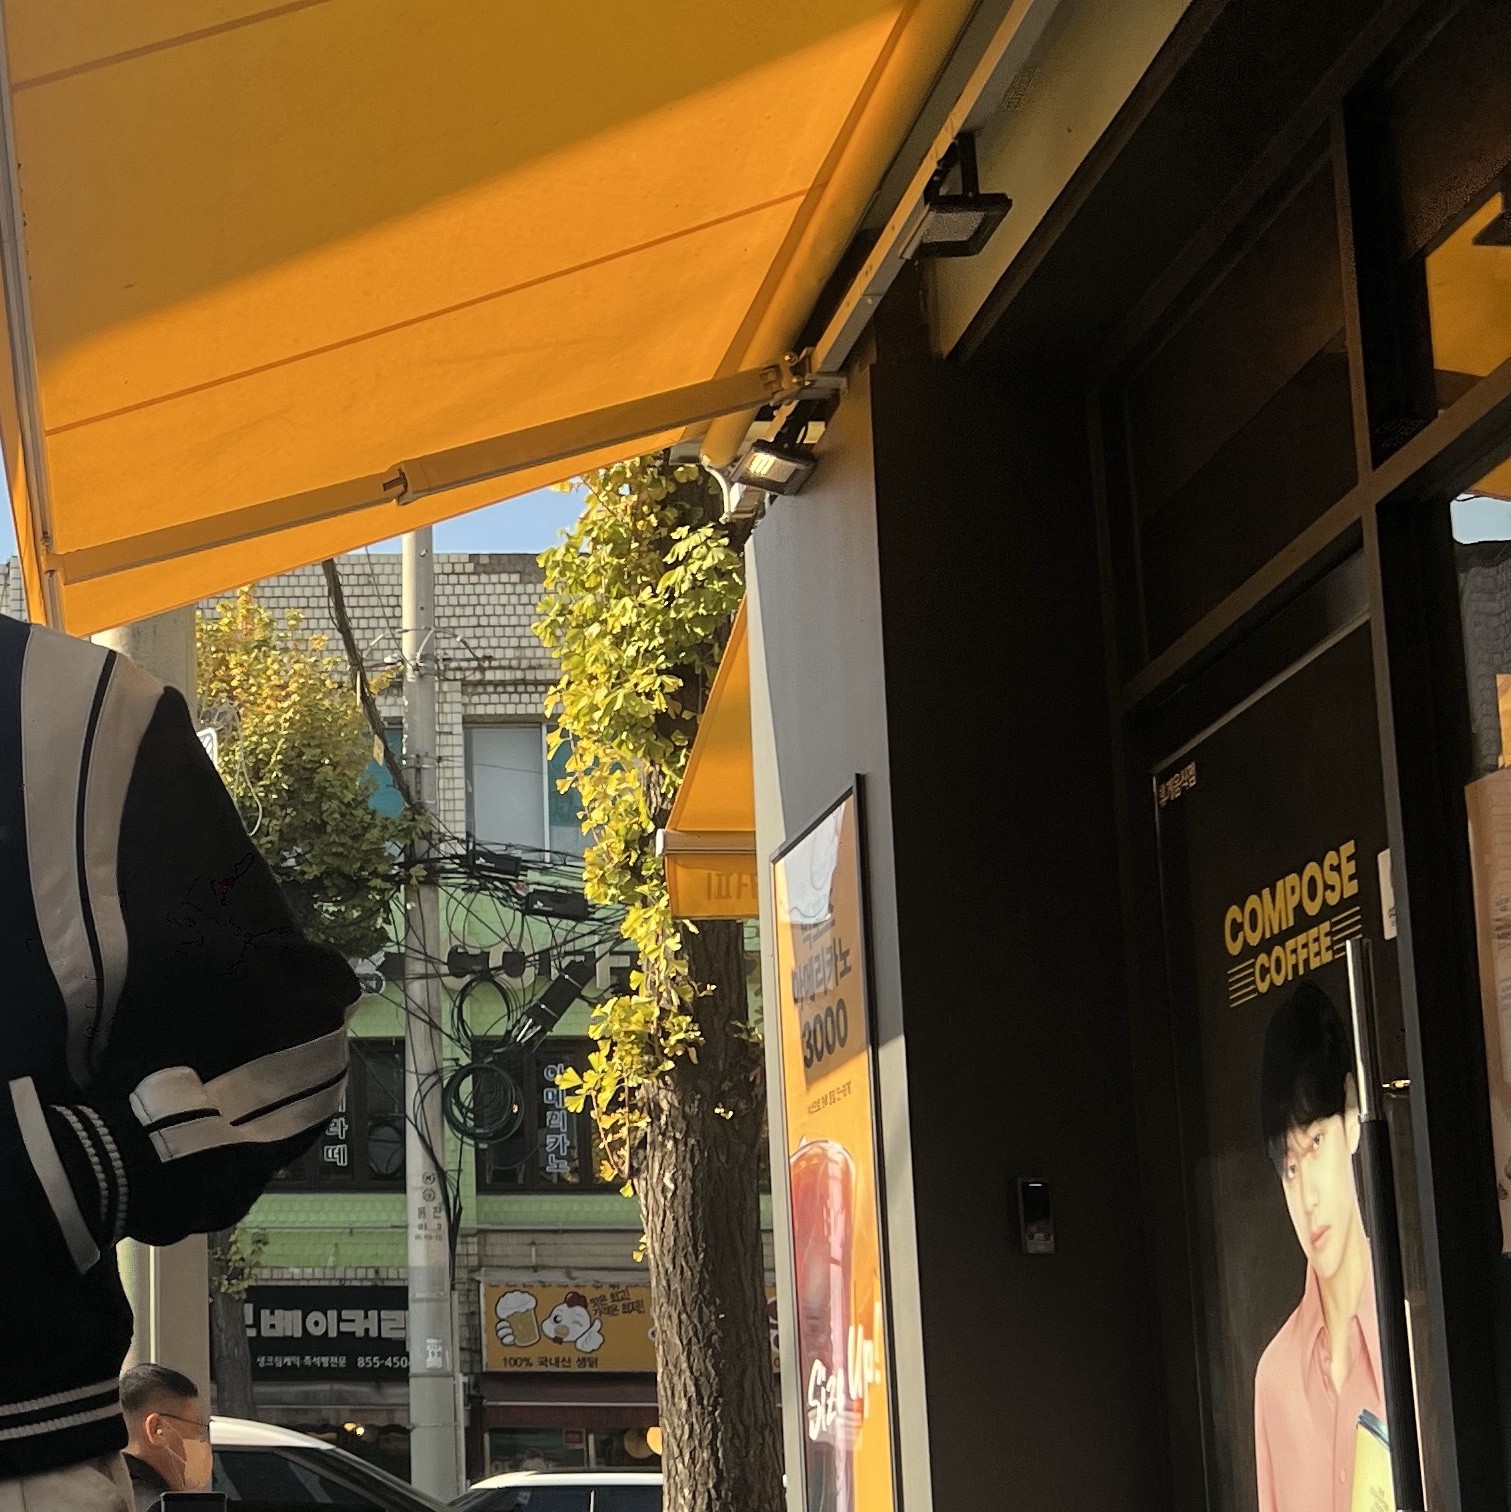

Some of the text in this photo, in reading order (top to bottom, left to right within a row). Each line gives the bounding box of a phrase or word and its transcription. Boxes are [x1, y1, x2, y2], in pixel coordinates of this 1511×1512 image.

[1224, 839, 1359, 956] COMPOSE
[1254, 920, 1334, 993] COFFEE
[801, 998, 848, 1069] 3000
[356, 1355, 409, 1368] 855-450
[503, 1356, 533, 1368] 100%
[537, 1356, 572, 1369] 국내산
[847, 1301, 882, 1420] Up!
